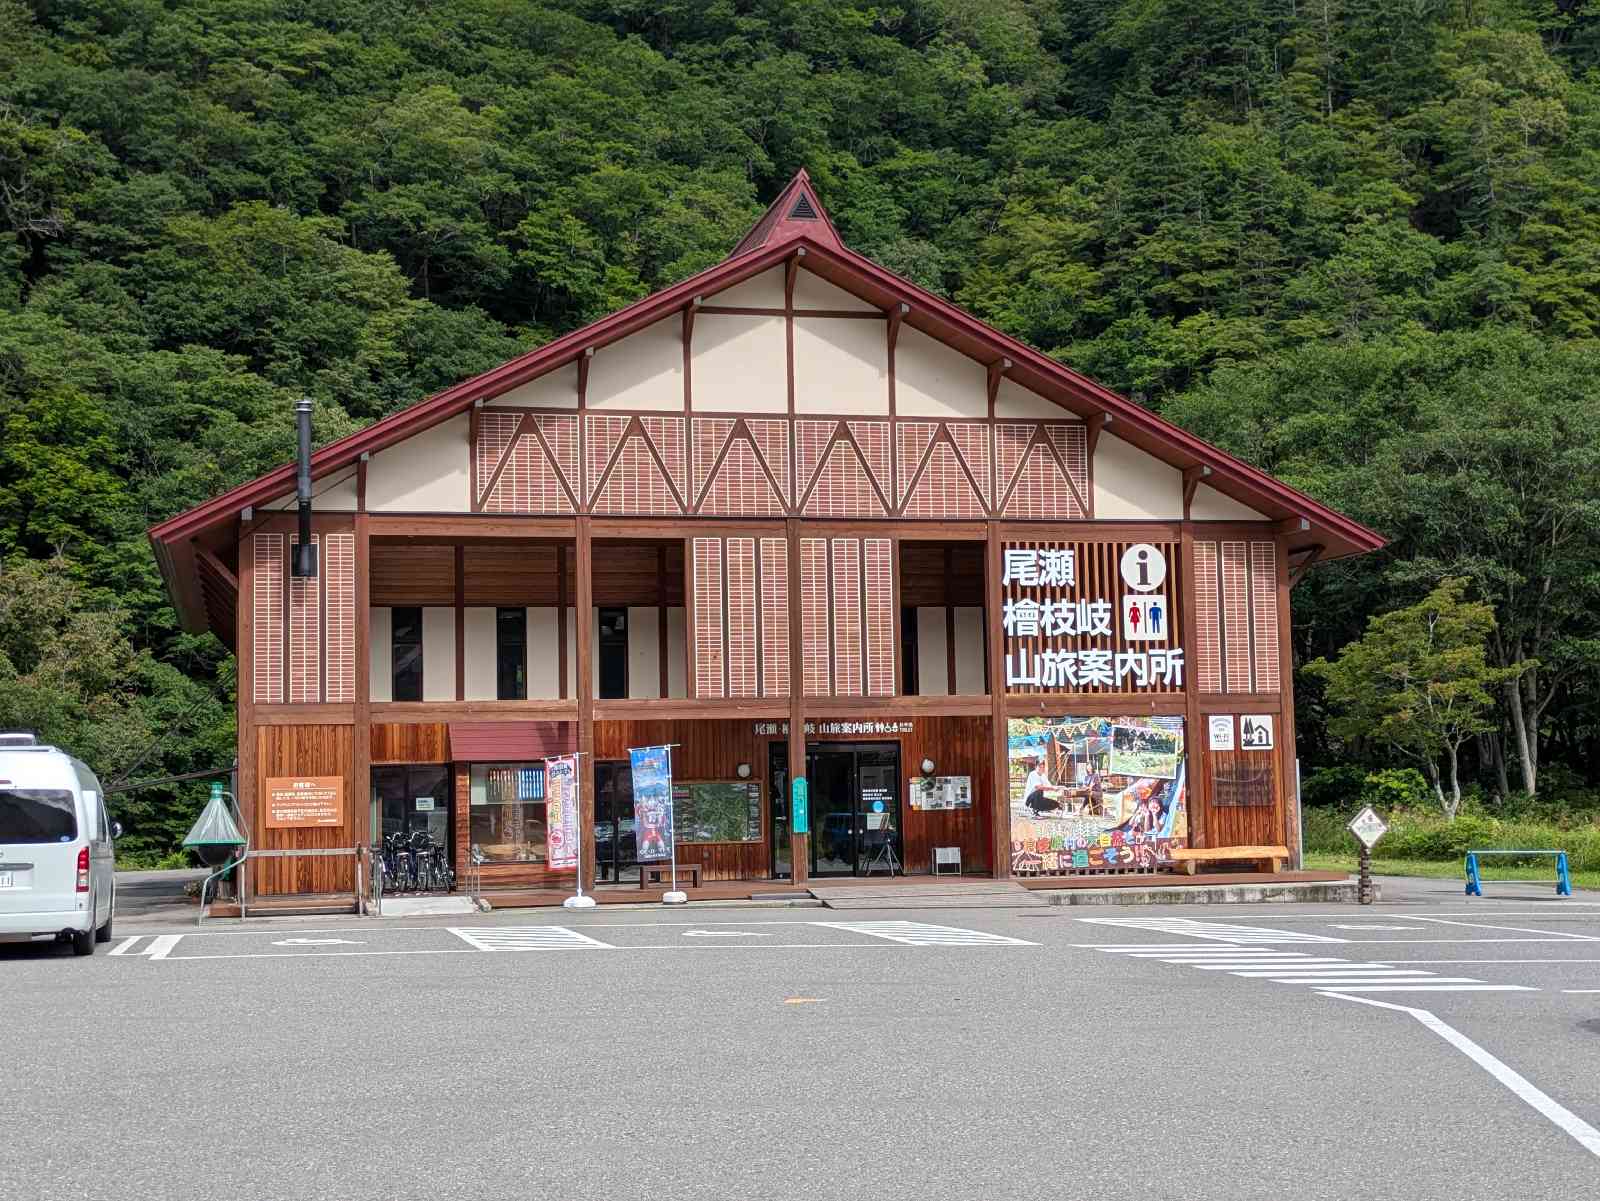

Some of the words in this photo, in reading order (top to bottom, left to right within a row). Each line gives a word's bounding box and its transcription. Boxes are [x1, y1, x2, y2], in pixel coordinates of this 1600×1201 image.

[1003, 549, 1075, 587] 尾瀬
[1003, 598, 1112, 637] 檜枝岐
[1005, 648, 1185, 687] 山旅案内所
[819, 721, 874, 735] 山旅案内所
